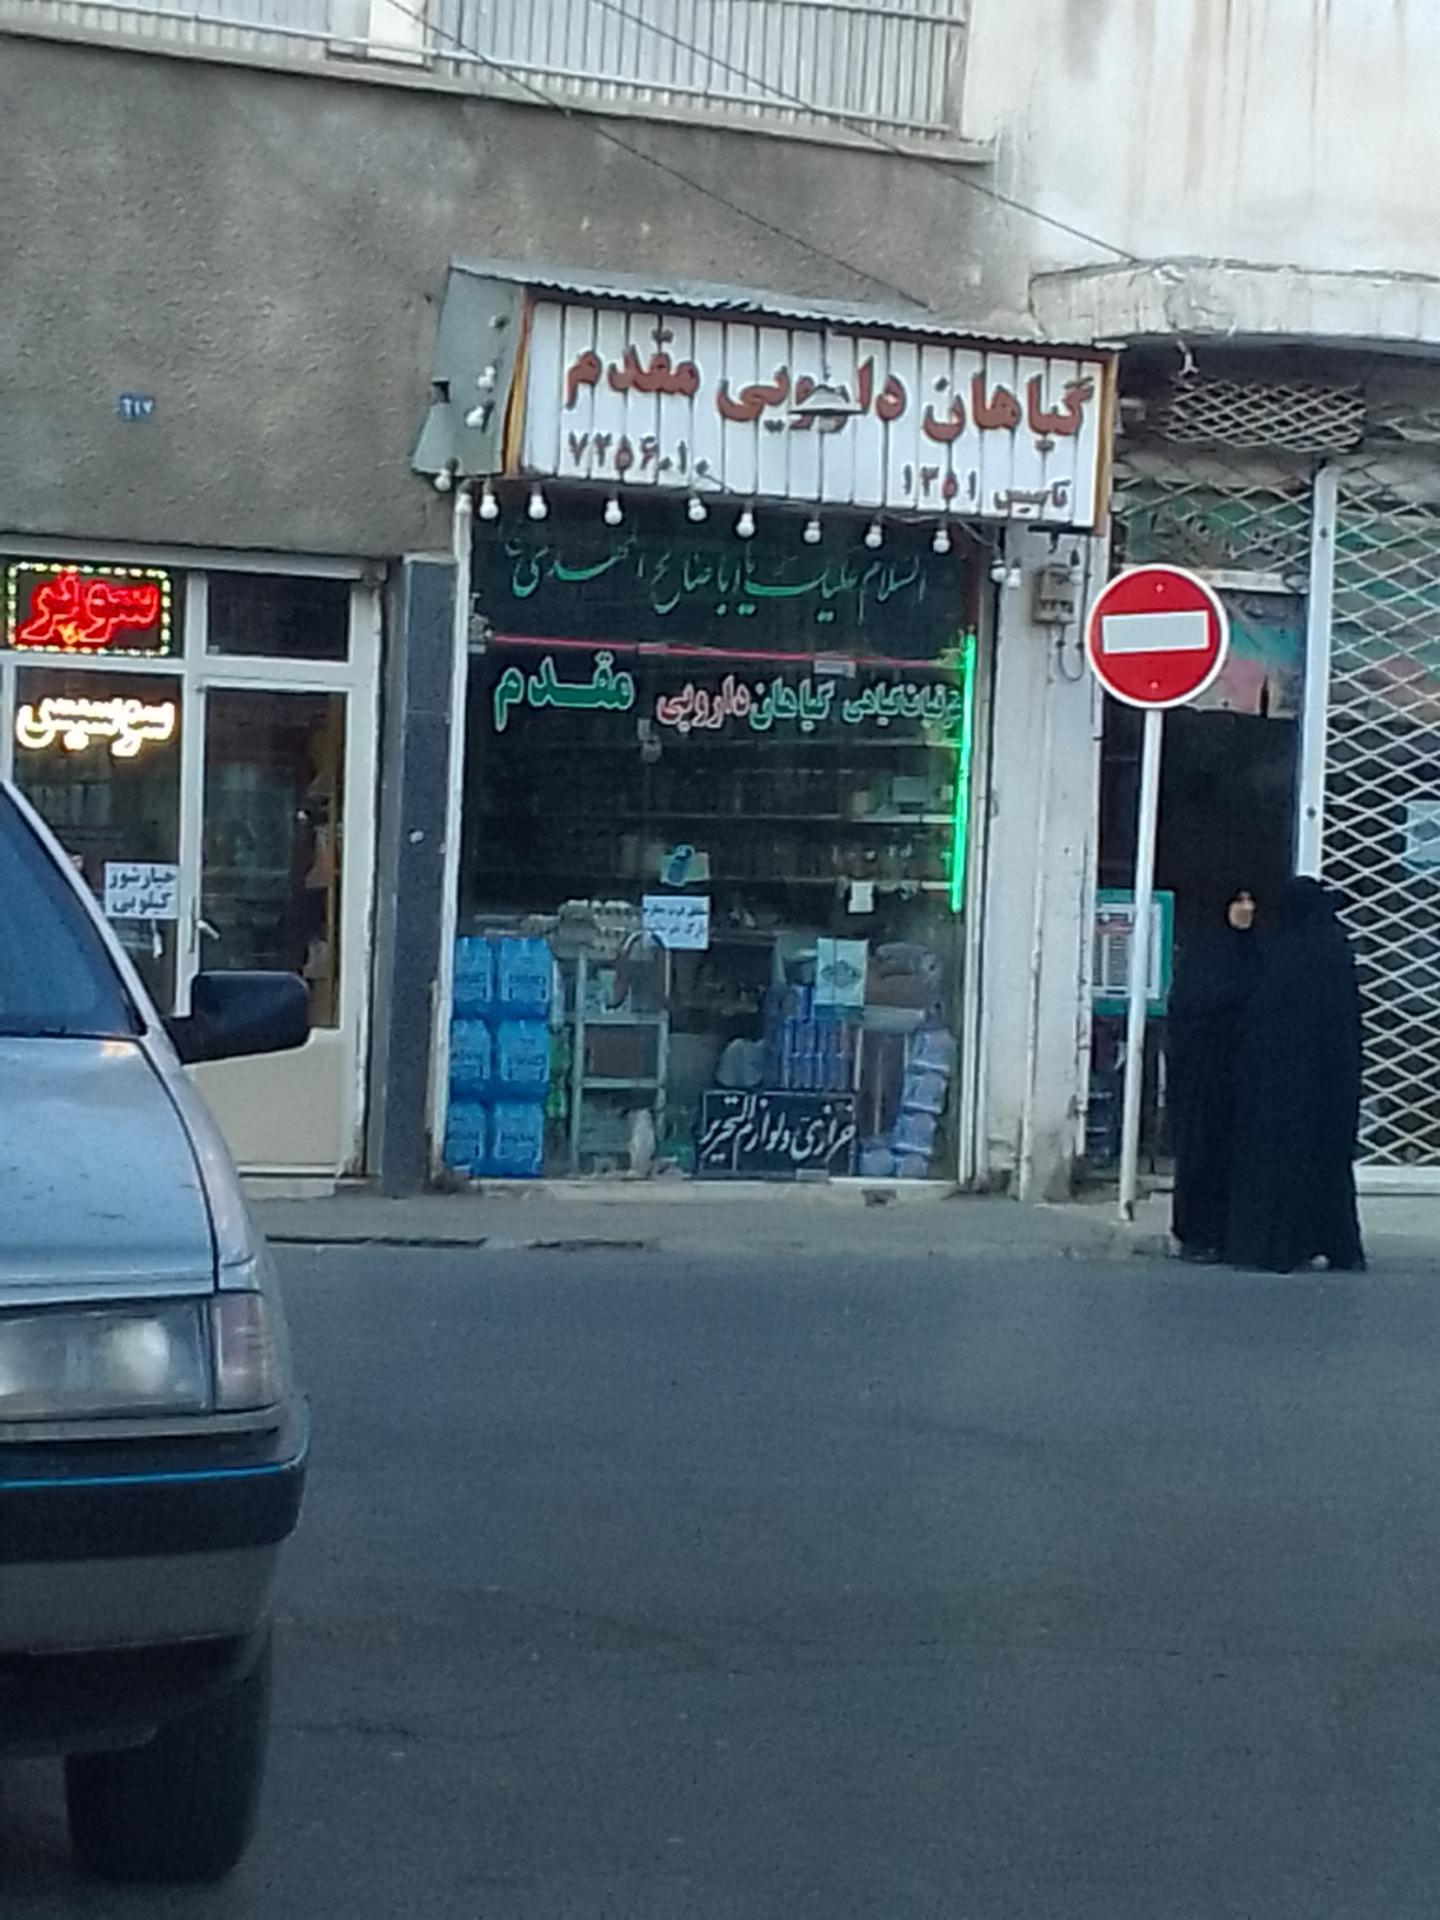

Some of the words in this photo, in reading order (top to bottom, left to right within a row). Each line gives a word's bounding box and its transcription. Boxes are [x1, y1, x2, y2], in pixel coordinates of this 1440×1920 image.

[567, 329, 700, 410] مقدم
[923, 369, 1095, 452] گیاهان
[21, 574, 158, 643] سوپر
[493, 651, 634, 732] مقدم
[656, 675, 751, 732] دارویی
[751, 677, 836, 731] گیاهان
[16, 698, 175, 757] سوسیس
[791, 1102, 856, 1162] خرازی
